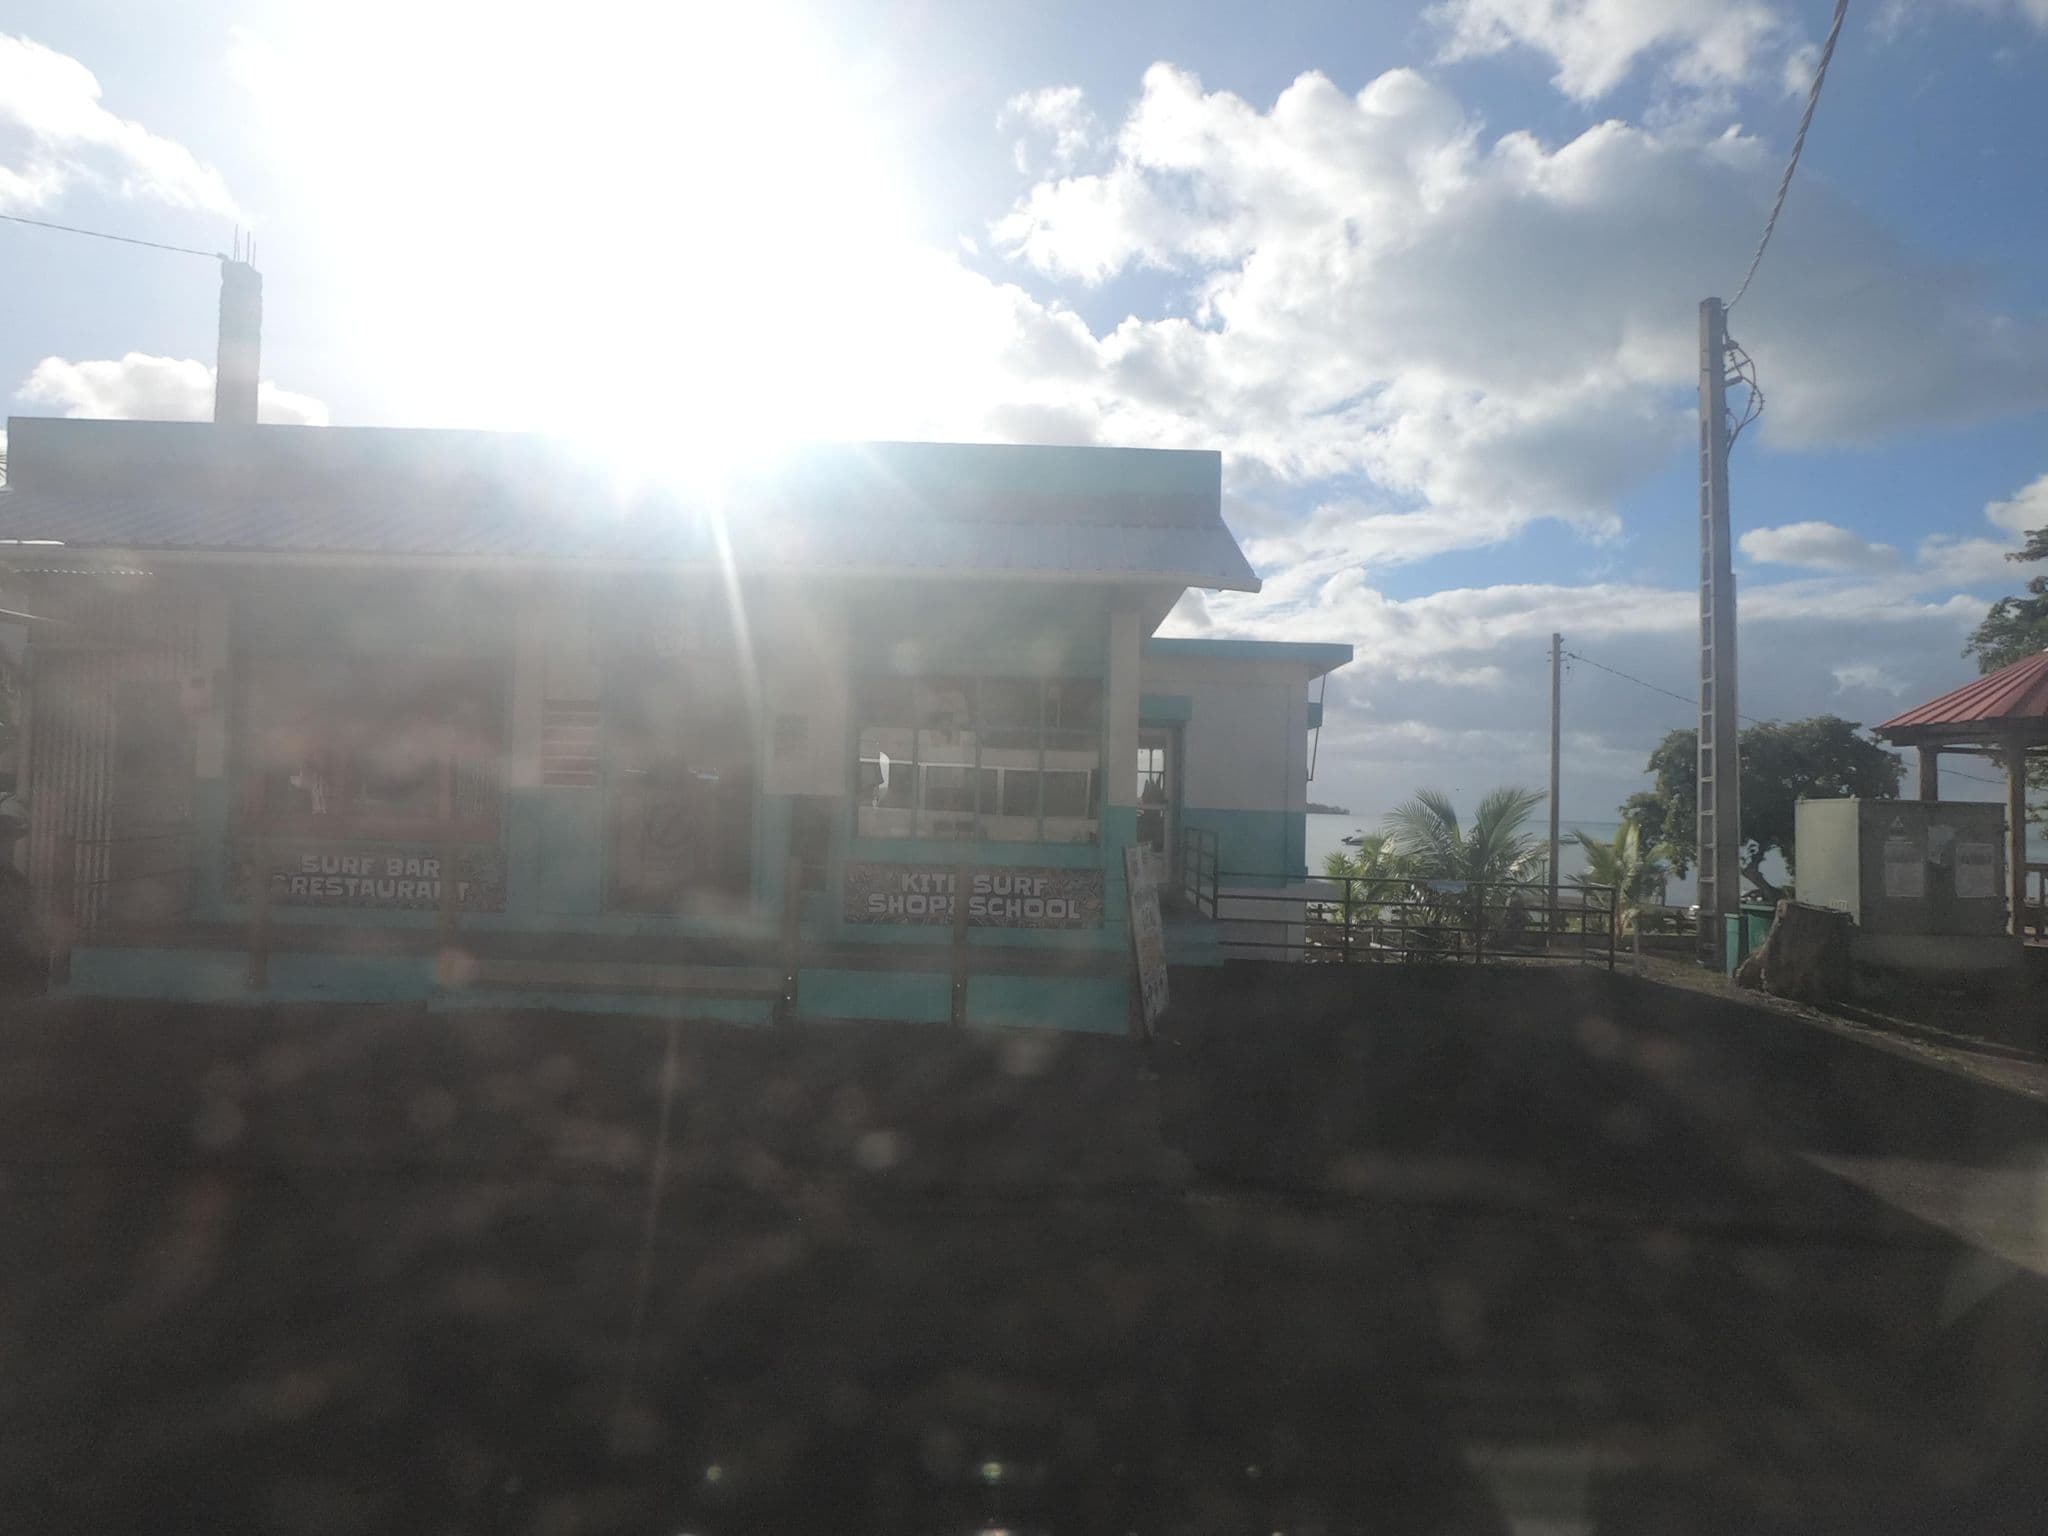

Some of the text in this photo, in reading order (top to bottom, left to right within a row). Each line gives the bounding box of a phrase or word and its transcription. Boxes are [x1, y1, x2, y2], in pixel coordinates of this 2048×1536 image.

[301, 855, 440, 878] SURF BAR
[290, 875, 471, 901] RESTAURAT
[973, 875, 1049, 897] SURF
[968, 895, 1081, 919] SCHOOL
